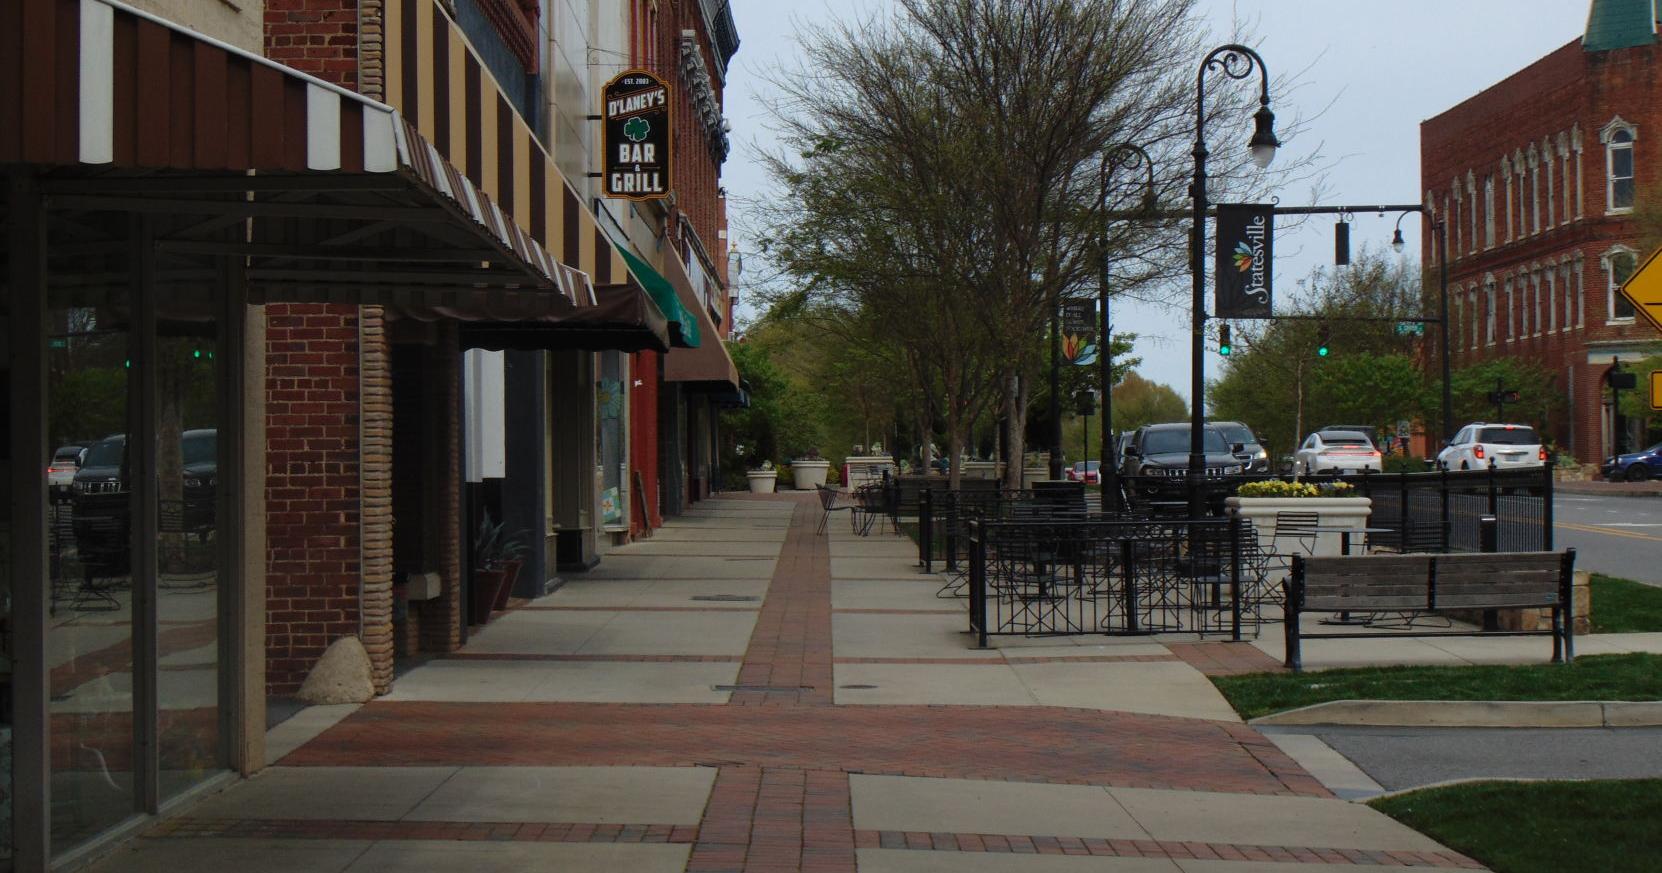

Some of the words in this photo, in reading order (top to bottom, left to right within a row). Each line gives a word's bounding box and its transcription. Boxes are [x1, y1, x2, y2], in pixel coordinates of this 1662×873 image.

[608, 89, 665, 117] D'LANEY'S
[619, 143, 655, 163] BAR
[635, 164, 640, 172] &
[611, 173, 662, 192] GRILL
[1244, 215, 1269, 304] Statesville
